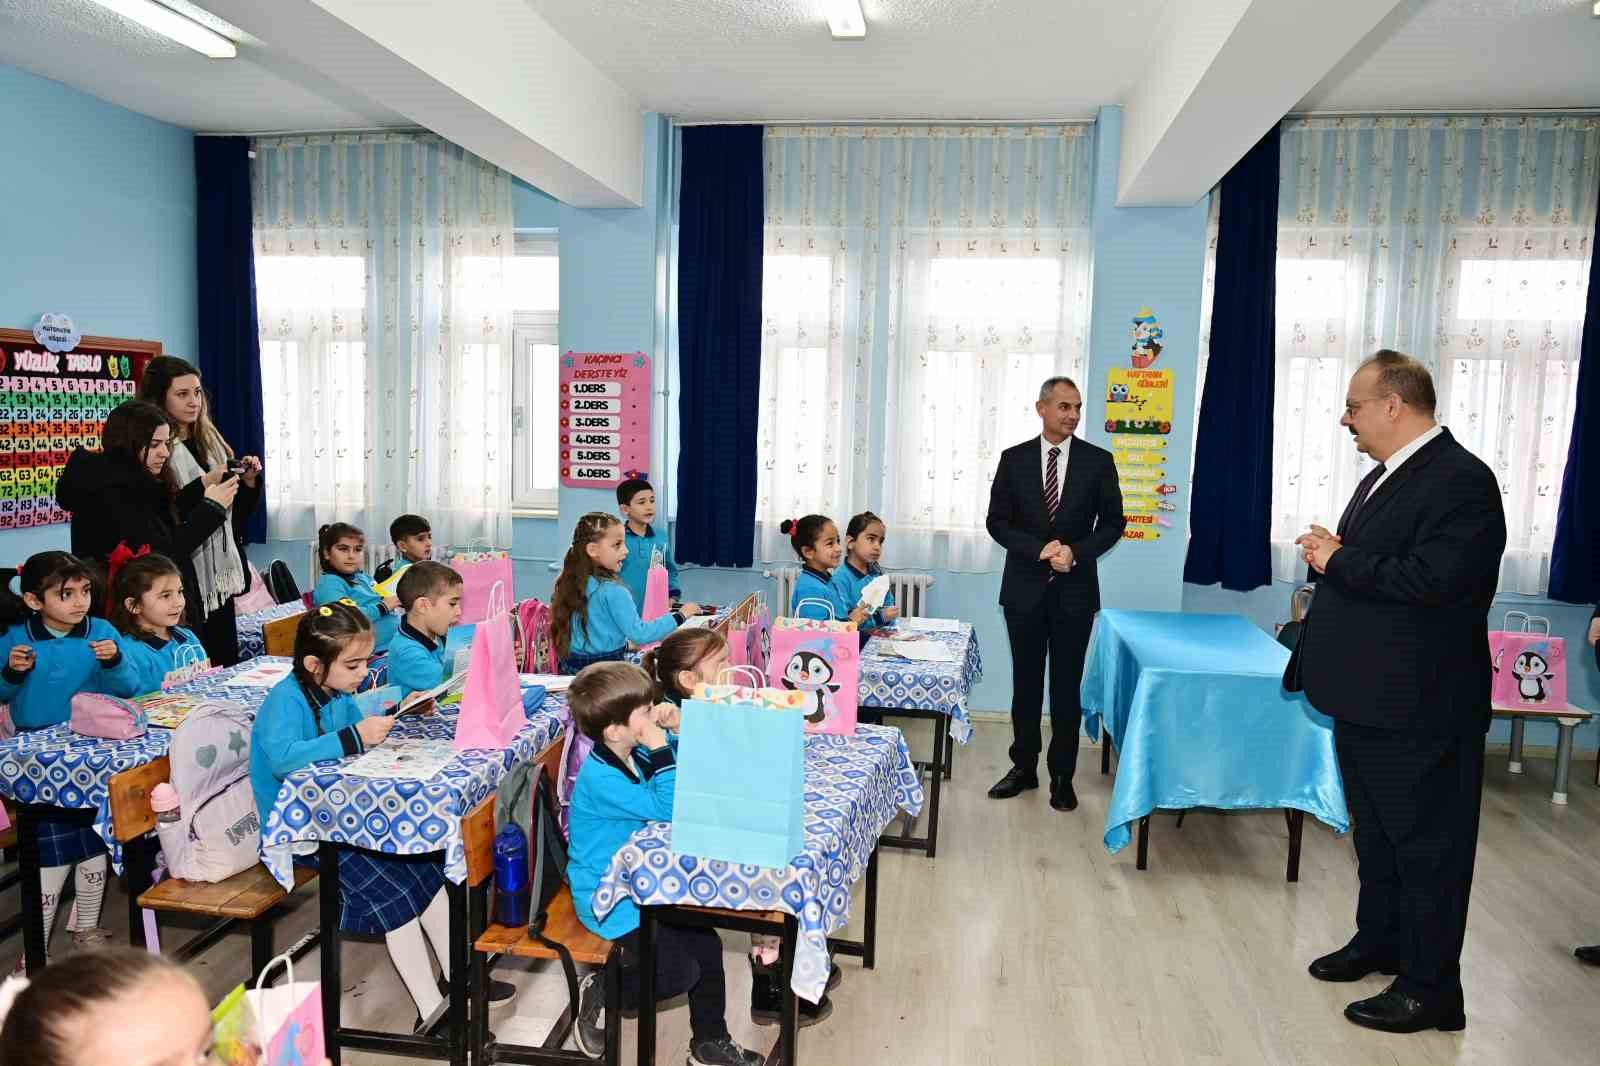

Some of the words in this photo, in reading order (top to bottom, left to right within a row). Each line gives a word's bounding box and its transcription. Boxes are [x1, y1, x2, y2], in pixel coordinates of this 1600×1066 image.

[66, 354, 102, 372] TABLO
[584, 355, 622, 366] KAÇINCI
[574, 368, 628, 378] DERSTEYİZ
[17, 380, 23, 390] 3
[35, 381, 41, 390] 4
[52, 381, 57, 390] 5
[68, 381, 74, 390] 6
[84, 382, 89, 391] 7
[126, 383, 132, 392] 10
[574, 384, 606, 393] 1.DERS
[0, 394, 7, 404] 2
[16, 394, 26, 404] 13
[36, 395, 45, 404] 14
[52, 395, 61, 404] 15
[70, 395, 78, 404] 16
[86, 396, 93, 404] 17
[574, 401, 608, 409] 2.DERS
[17, 409, 28, 420] 23
[36, 409, 46, 419] 24
[53, 409, 62, 419] 25
[69, 410, 78, 419] 26
[85, 410, 93, 419] 27
[575, 418, 609, 427] 3.DERS
[18, 424, 29, 435] 33
[36, 424, 46, 433] 34
[53, 424, 62, 433] 35
[70, 424, 79, 433] 36
[86, 424, 94, 433] 37
[19, 440, 30, 450] 43
[37, 440, 47, 449] 44
[53, 440, 64, 448] 45
[69, 439, 80, 448] 46
[86, 438, 95, 447] 47
[576, 434, 610, 444] 4.DERS
[37, 456, 48, 464] 54
[54, 454, 64, 462] 55
[577, 451, 610, 460] 5.DERS
[0, 472, 12, 481] 62
[19, 470, 31, 480] 63
[38, 469, 49, 478] 64
[577, 469, 610, 478] 6.DERS
[2, 486, 12, 496] 72
[21, 485, 31, 495] 73
[39, 484, 48, 493] 74
[1, 516, 12, 526] 92
[20, 515, 31, 525] 93
[37, 513, 48, 523] 94
[53, 511, 64, 520] 95
